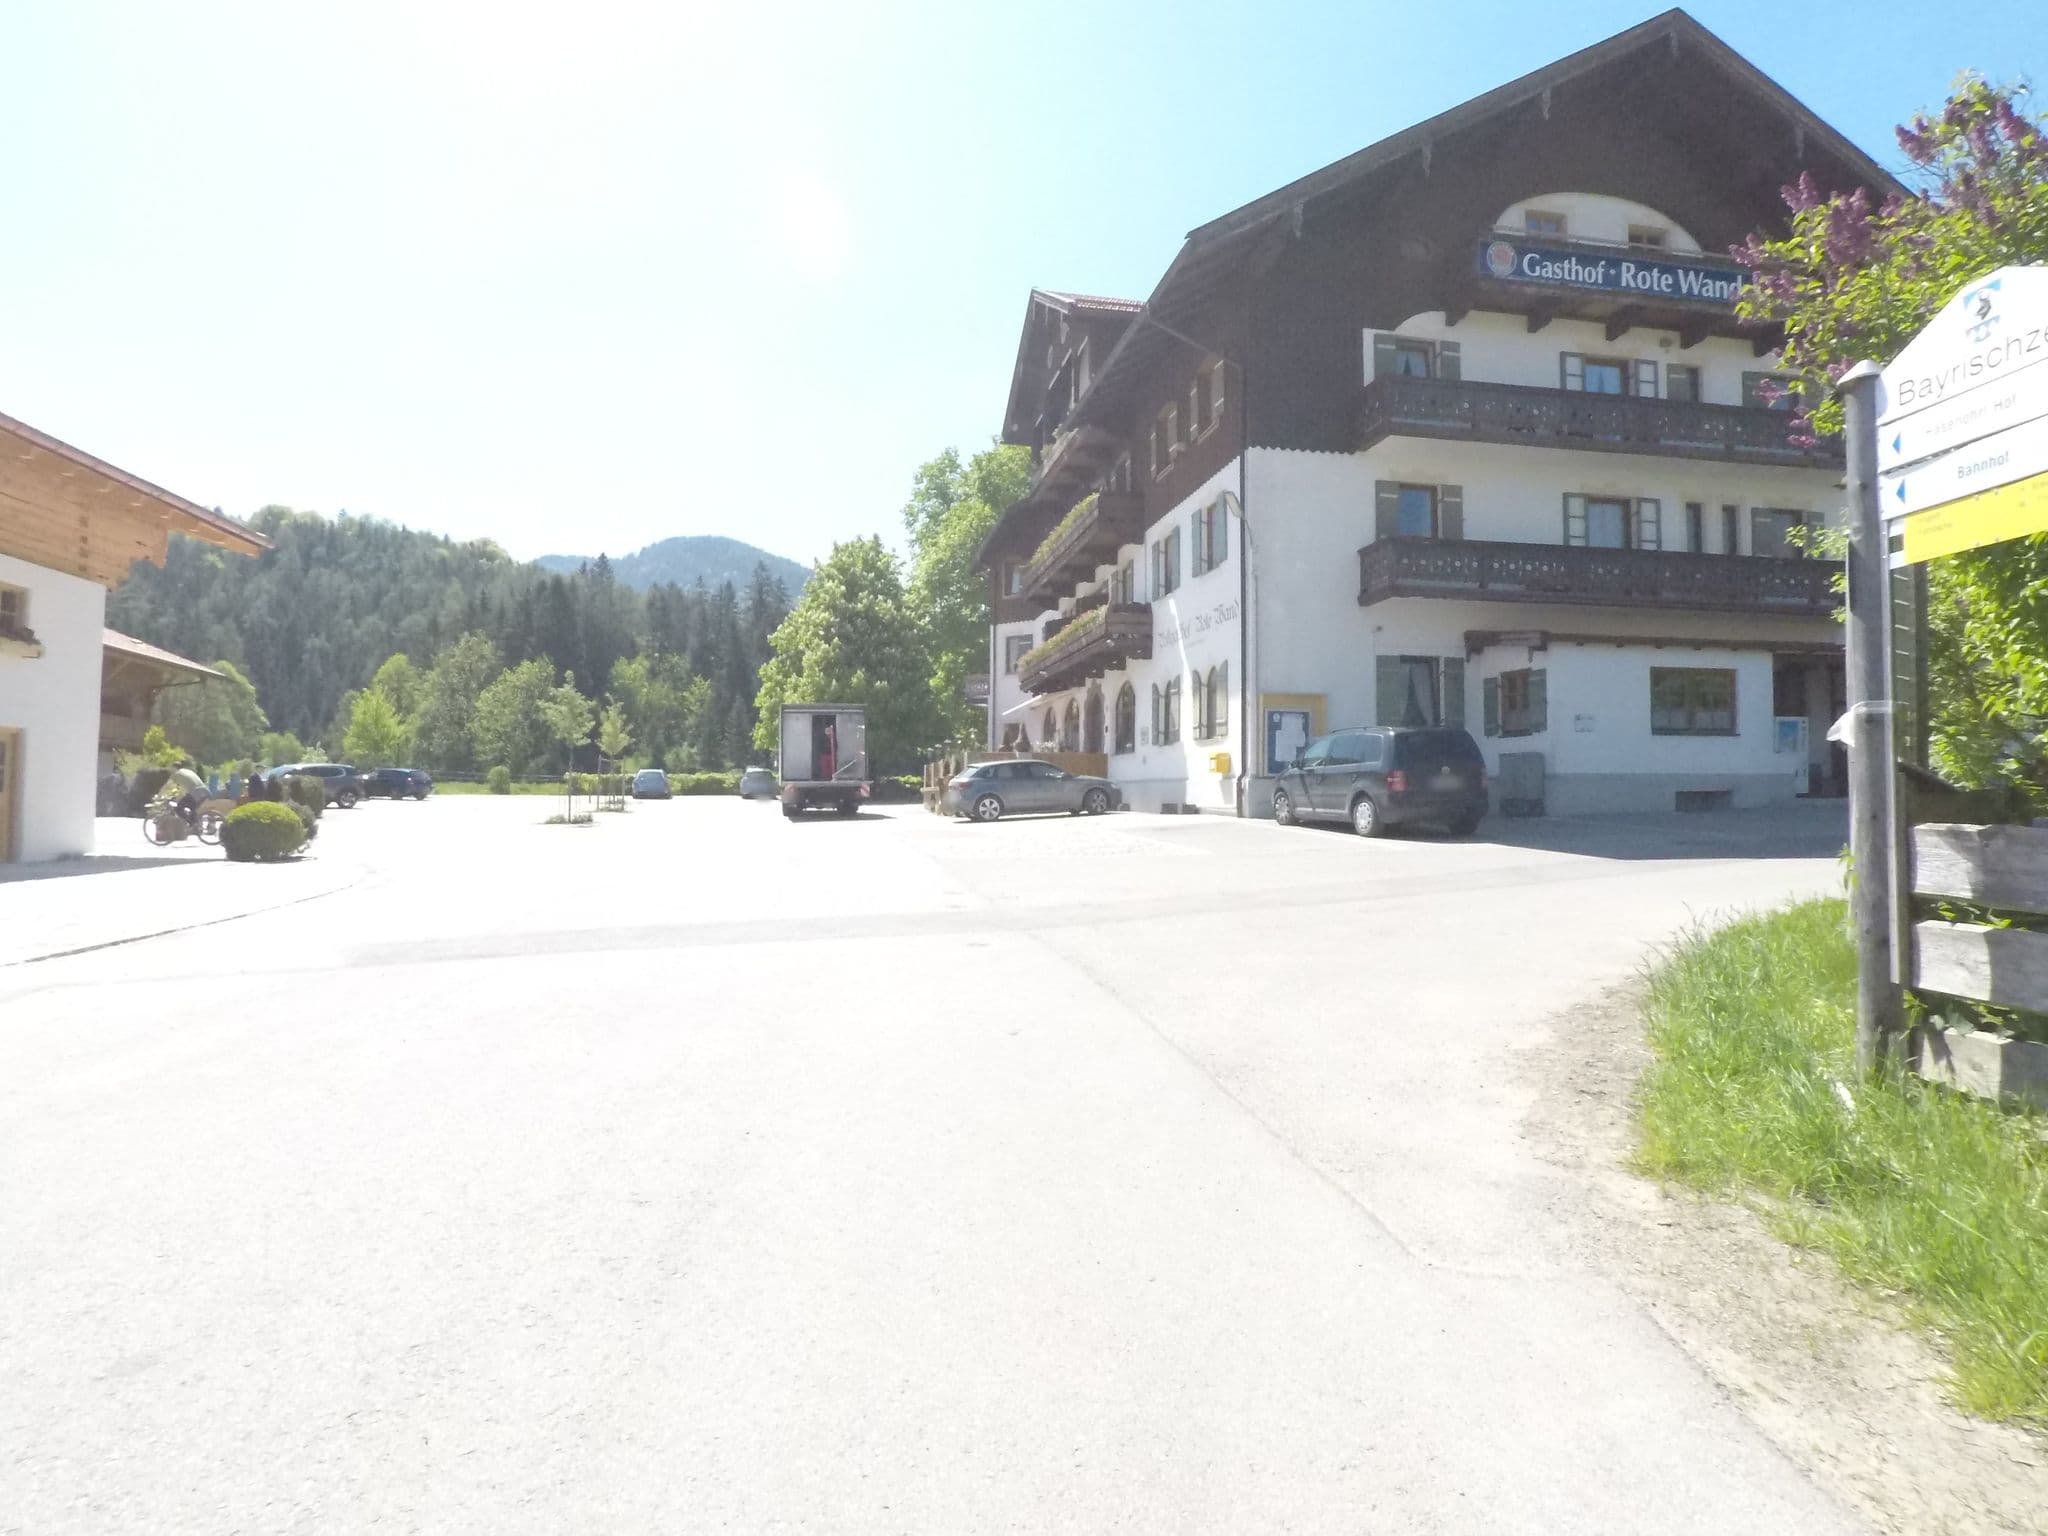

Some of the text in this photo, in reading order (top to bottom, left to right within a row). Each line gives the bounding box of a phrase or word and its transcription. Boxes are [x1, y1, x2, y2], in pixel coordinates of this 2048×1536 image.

[1522, 253, 1606, 284] Gasthof
[1621, 262, 1673, 292] Rote
[1957, 451, 2010, 479] Bahnhof
